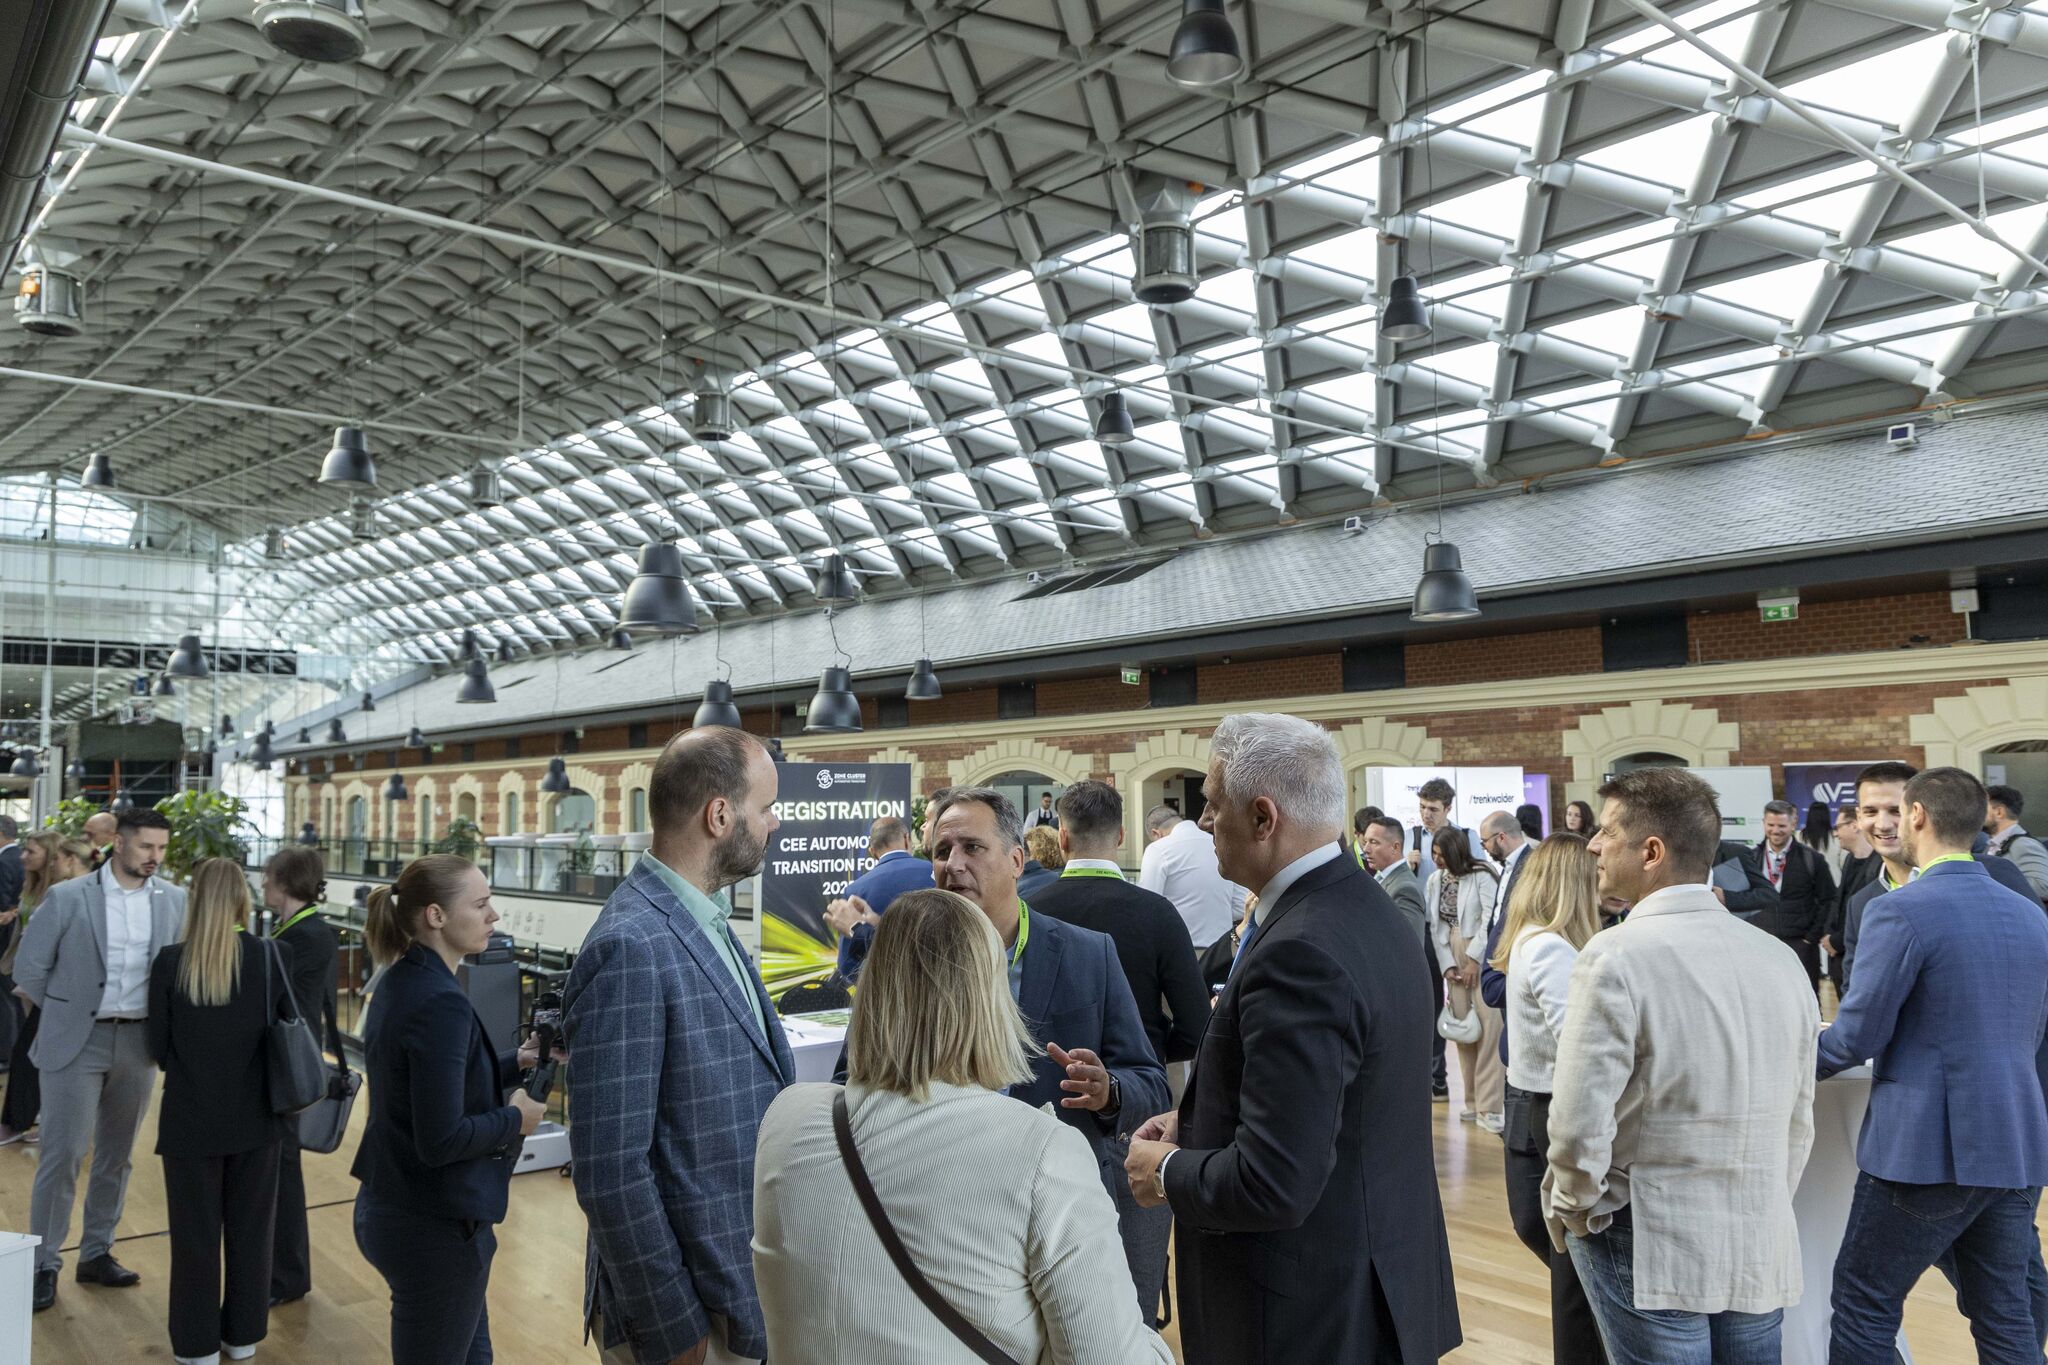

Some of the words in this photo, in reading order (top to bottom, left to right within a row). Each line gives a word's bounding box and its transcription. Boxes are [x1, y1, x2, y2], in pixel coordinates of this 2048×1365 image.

[770, 801, 905, 821] REGISTRATION
[780, 838, 807, 852] CEE
[810, 836, 871, 851] AUTOMO
[772, 858, 854, 875] TRANSITION
[857, 858, 879, 871] FO
[822, 880, 855, 895] 202
